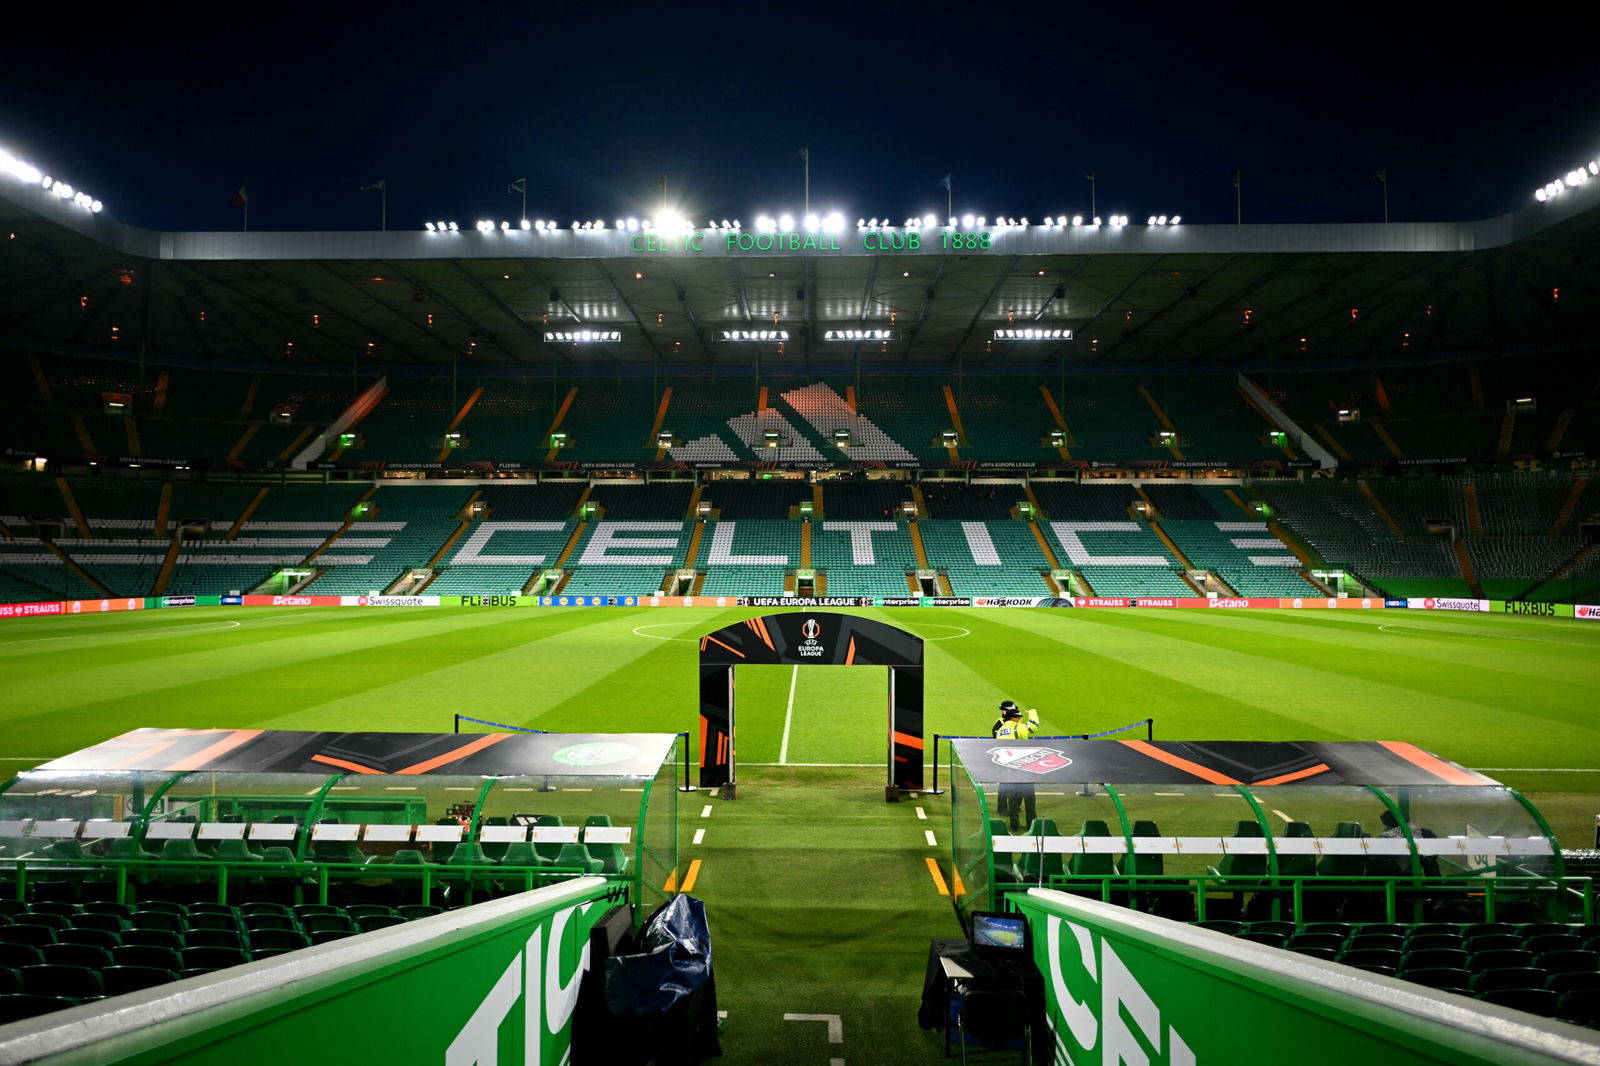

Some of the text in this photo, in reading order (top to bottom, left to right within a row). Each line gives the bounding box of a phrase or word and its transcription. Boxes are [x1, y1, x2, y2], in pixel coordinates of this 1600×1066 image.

[630, 232, 991, 252] CELTIC FOOTBALL CLUB 1888
[450, 521, 1169, 565] CELTIC
[163, 597, 195, 607] enterprise
[272, 595, 312, 606] Betano
[369, 596, 424, 606] Swissquote
[753, 597, 855, 606] UEFA EUROPA LEAGUE
[876, 597, 920, 607] enterprise
[925, 597, 970, 607] enterprise
[1209, 598, 1249, 608] Betano
[1436, 599, 1478, 610] Swissquote
[24, 604, 60, 614] STRAUSS
